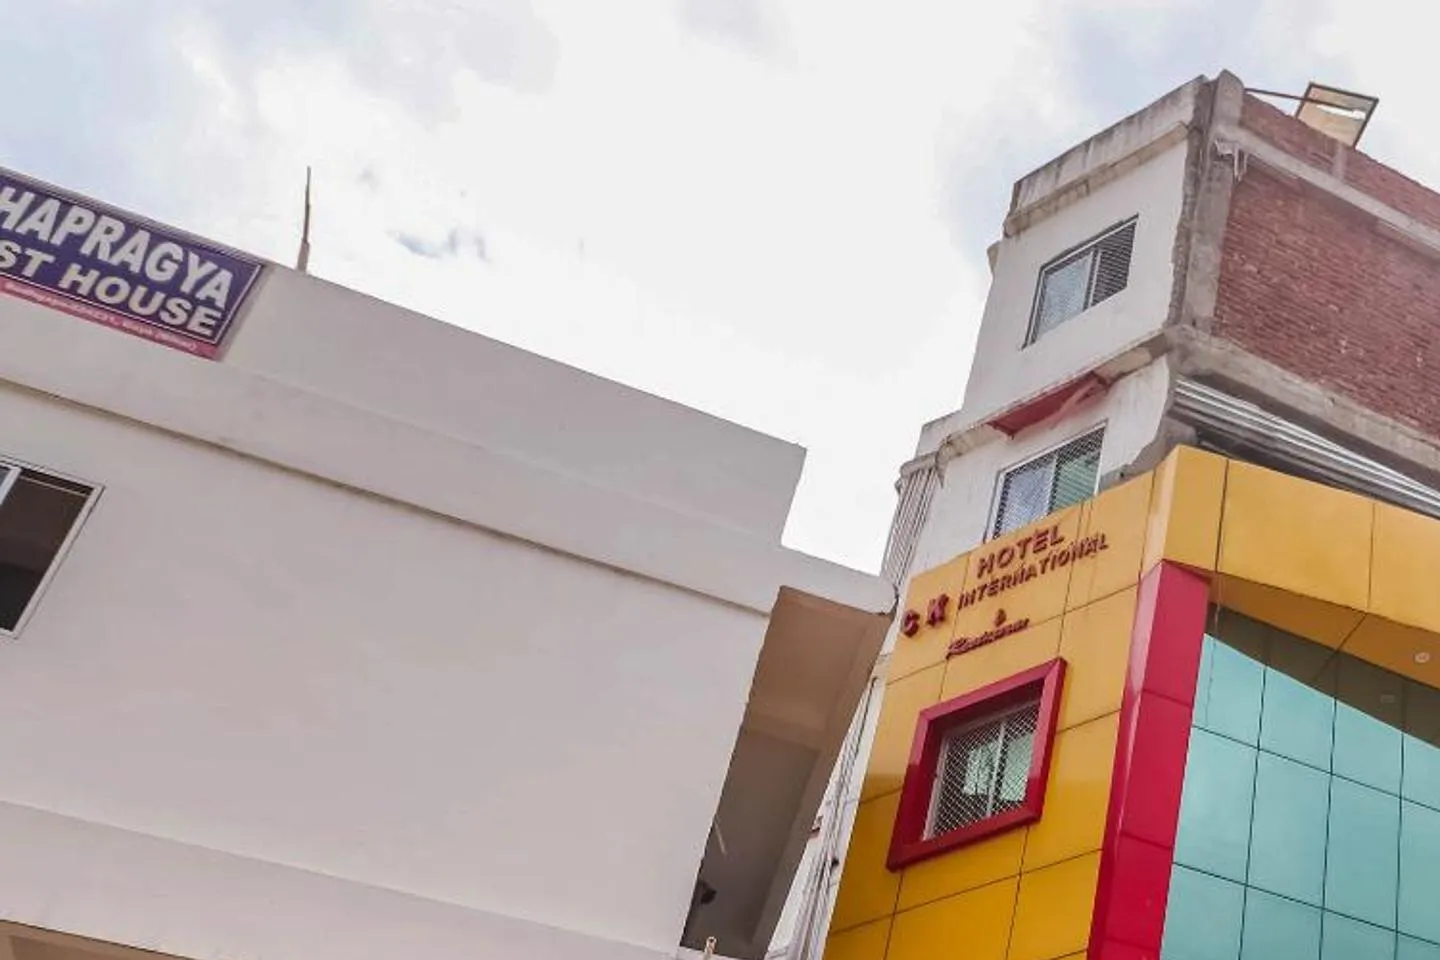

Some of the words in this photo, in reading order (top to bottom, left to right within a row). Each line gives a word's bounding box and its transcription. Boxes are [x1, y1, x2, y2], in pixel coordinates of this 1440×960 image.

[58, 263, 222, 337] HOUSE
[958, 531, 1109, 610] INTERNATIONAL
[976, 524, 1065, 579] HOTEL
